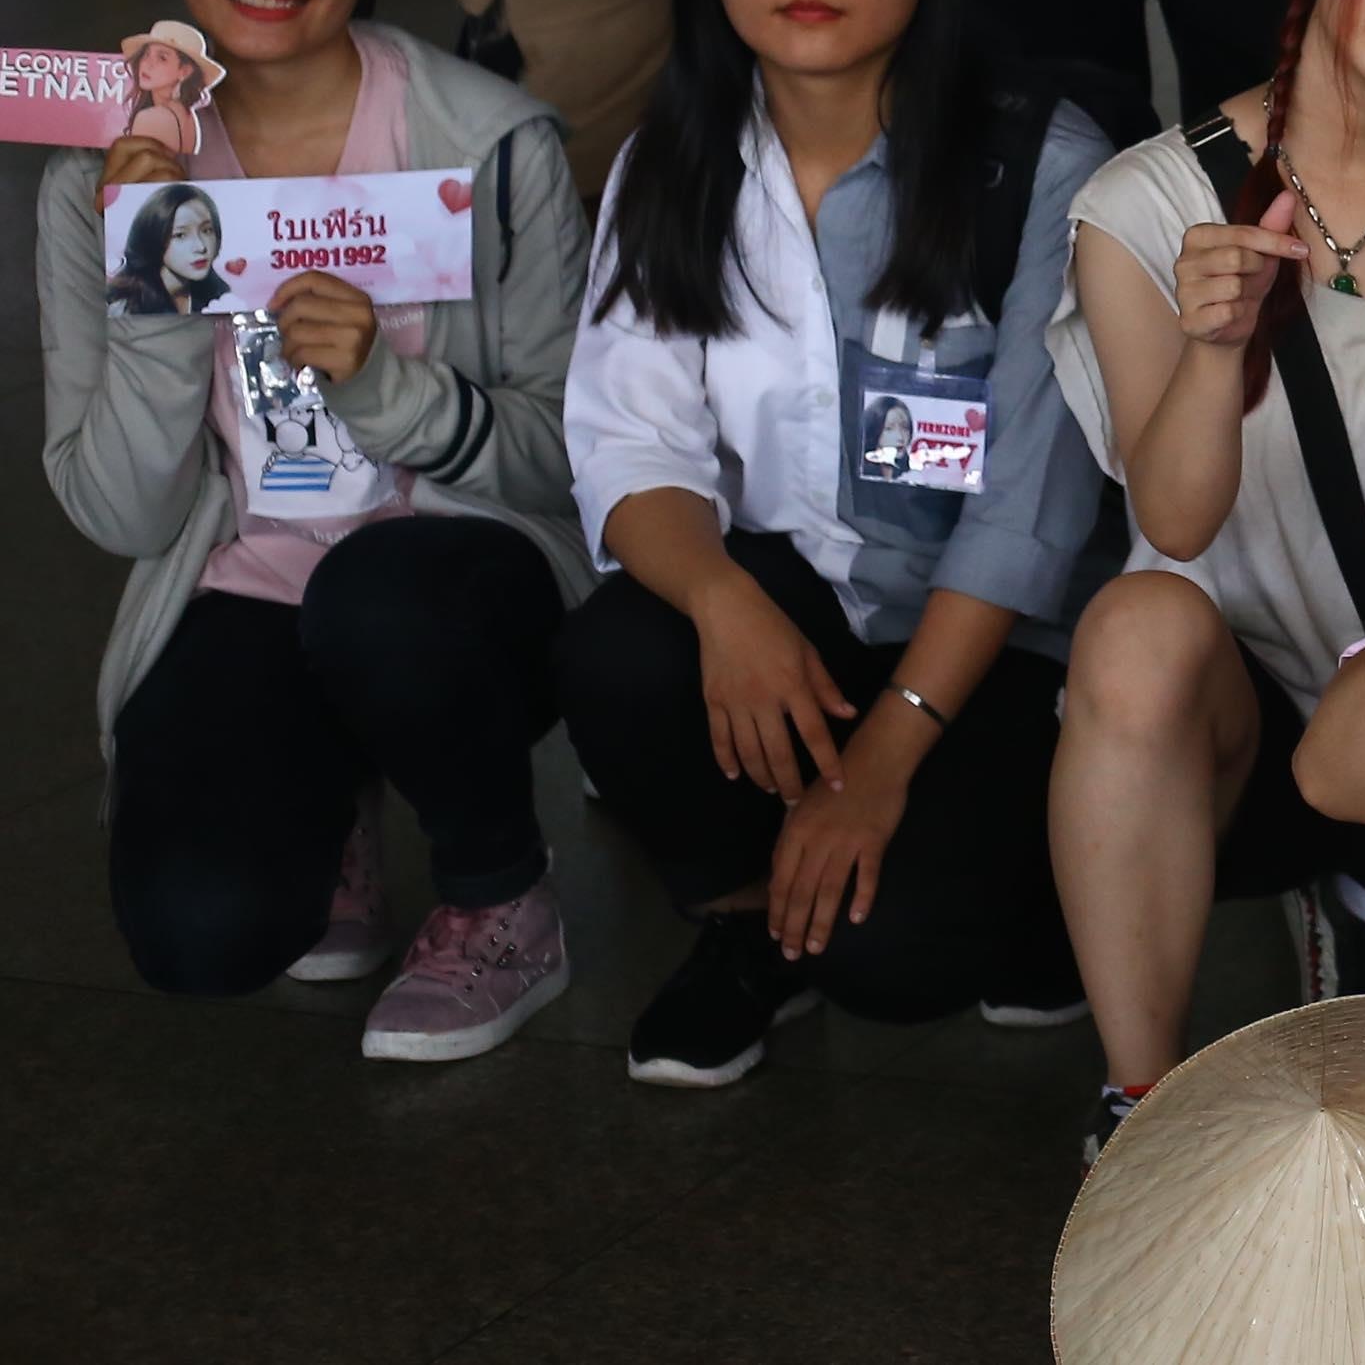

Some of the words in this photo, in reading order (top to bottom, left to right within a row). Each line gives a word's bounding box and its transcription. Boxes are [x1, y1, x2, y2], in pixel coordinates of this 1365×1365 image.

[2, 51, 89, 78] LCOME
[97, 58, 129, 80] TO
[0, 70, 124, 105] ETNAM
[270, 244, 387, 270] 30091992
